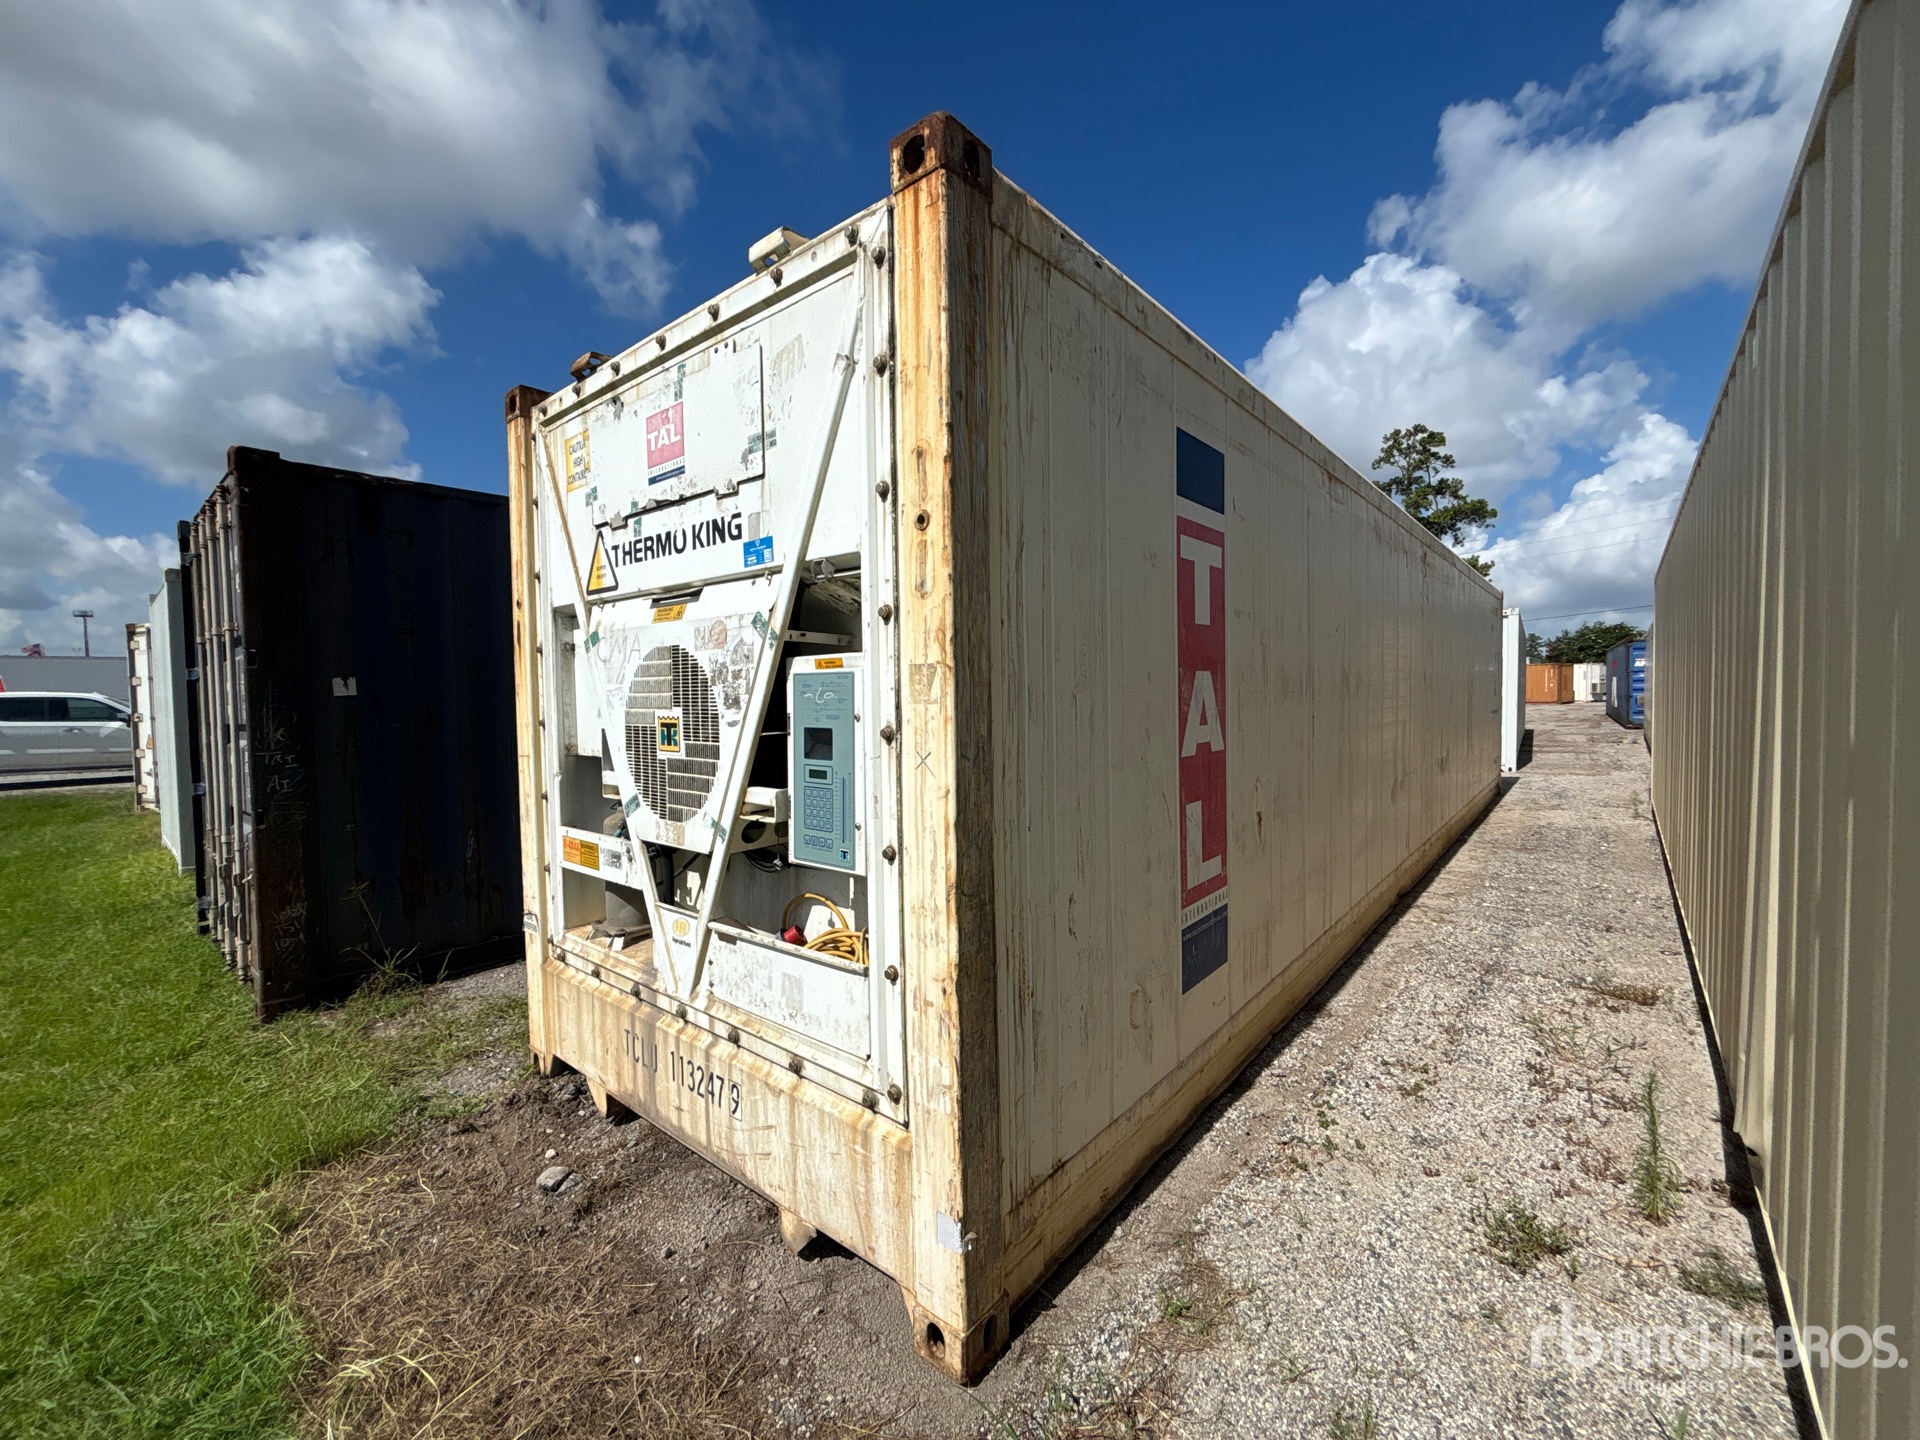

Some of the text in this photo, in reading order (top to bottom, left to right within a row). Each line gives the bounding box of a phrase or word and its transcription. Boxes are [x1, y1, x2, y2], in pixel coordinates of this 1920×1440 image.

[647, 424, 682, 451] TAL
[611, 512, 742, 568] THERMO KING
[1180, 534, 1225, 890] TAL
[1181, 889, 1229, 924] INTERNATIONAL
[624, 1029, 658, 1073] TCLU
